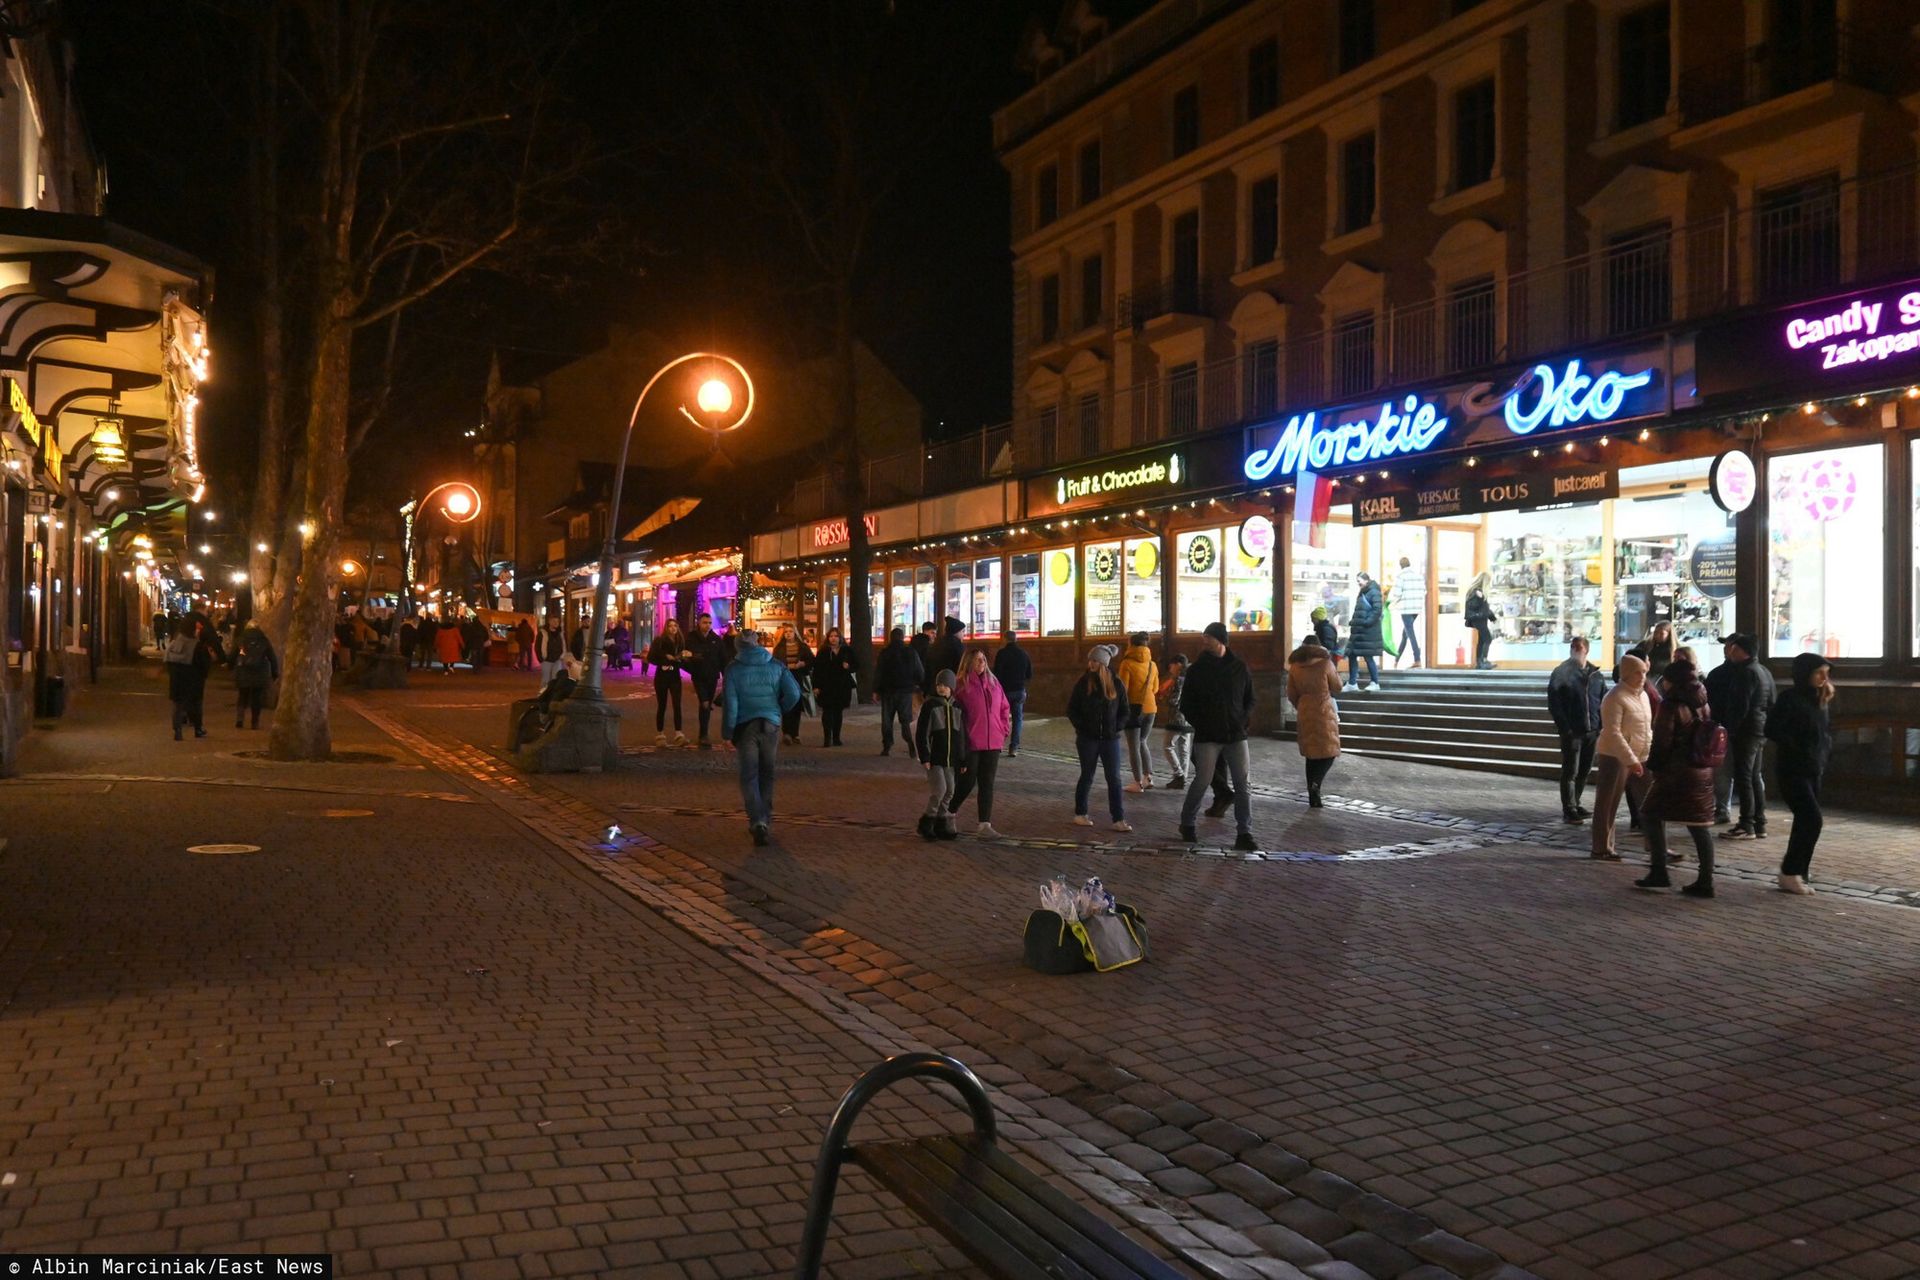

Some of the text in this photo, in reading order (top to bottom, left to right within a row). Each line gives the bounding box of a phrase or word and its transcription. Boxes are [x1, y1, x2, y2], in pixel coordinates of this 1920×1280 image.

[1786, 300, 1883, 349] Candy
[1244, 359, 1652, 480] Morskie Oko
[1067, 461, 1166, 498] Fruit & Chocolate
[1480, 482, 1529, 503] TOUS
[1360, 496, 1400, 516] KARL
[1417, 488, 1461, 505] VERSACE
[815, 515, 876, 547] ROSSMN
[1697, 561, 1717, 569] -20%
